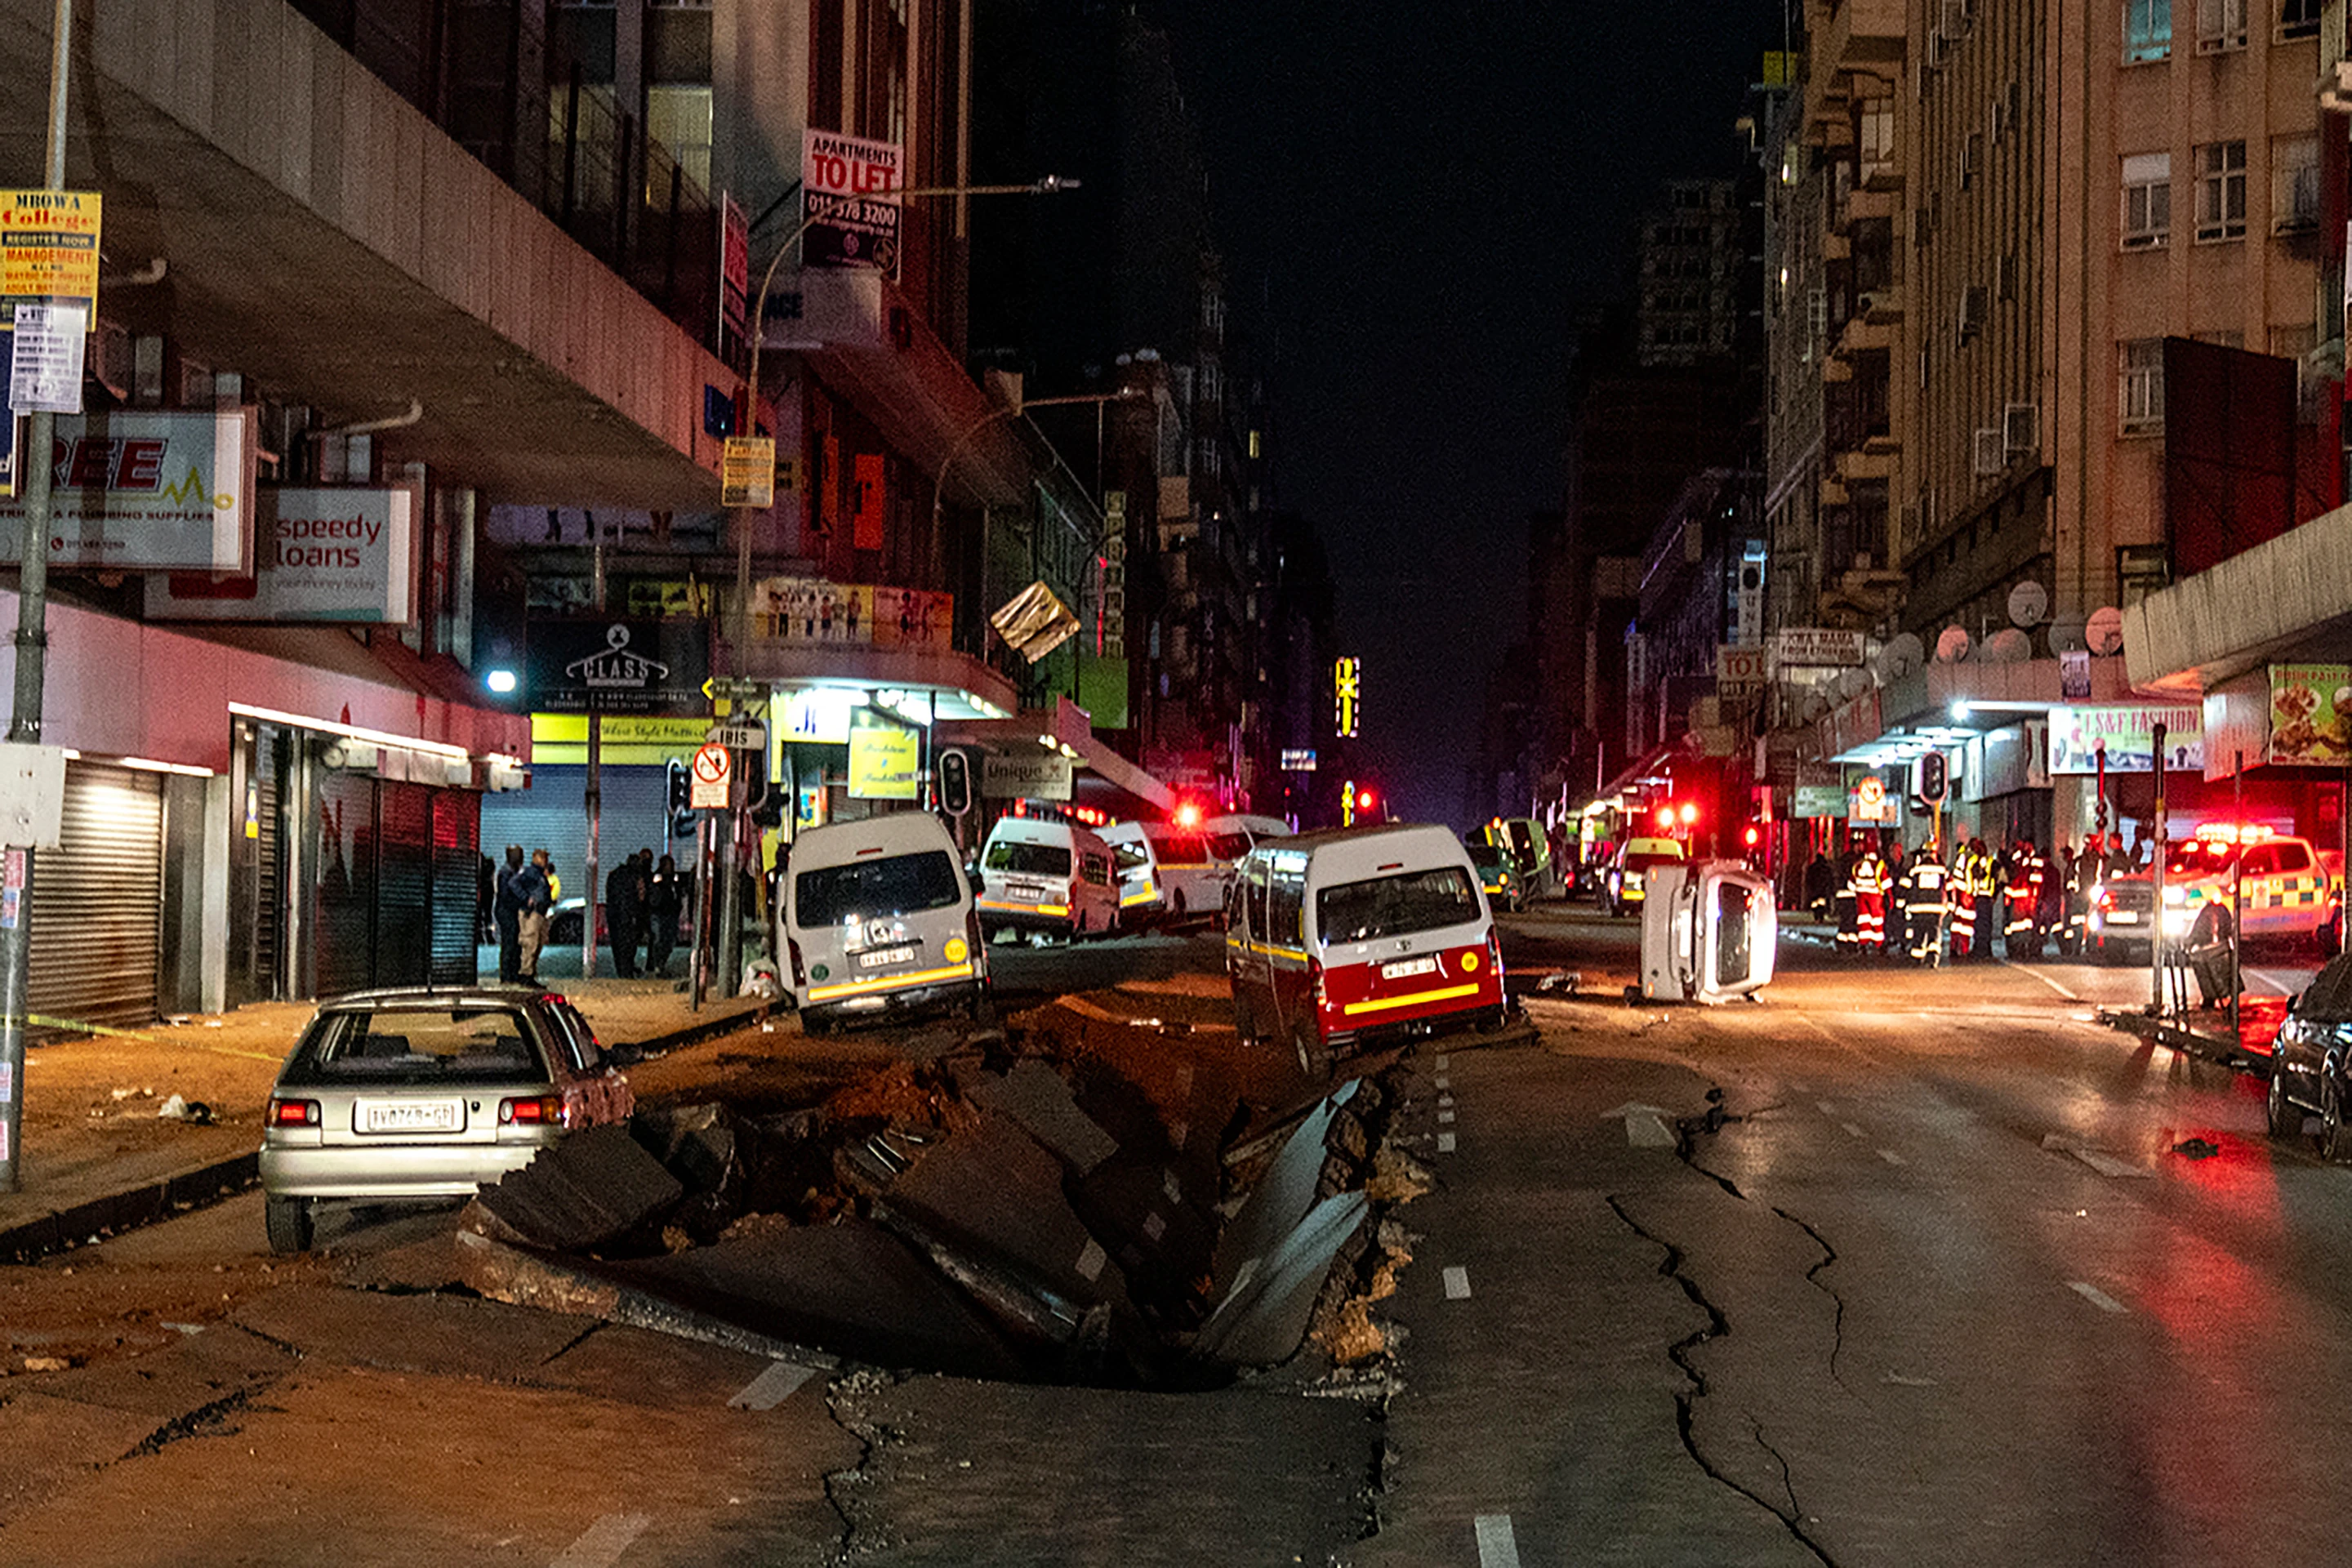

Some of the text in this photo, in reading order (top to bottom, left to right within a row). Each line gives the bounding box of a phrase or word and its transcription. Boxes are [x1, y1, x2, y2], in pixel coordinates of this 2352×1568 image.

[813, 136, 897, 167] APARTMENTS
[813, 154, 896, 194] TO LET
[862, 203, 896, 227] 3200
[6, 248, 92, 264] MANAGEMENT
[68, 510, 143, 521] PLUMBING
[146, 511, 214, 522] SUPPLIES
[276, 512, 381, 547] speedy
[275, 540, 361, 568] loans
[583, 658, 649, 679] CLASS
[2131, 708, 2198, 733] FASHION
[719, 729, 748, 746] IBIS
[988, 763, 1042, 782] Unique
